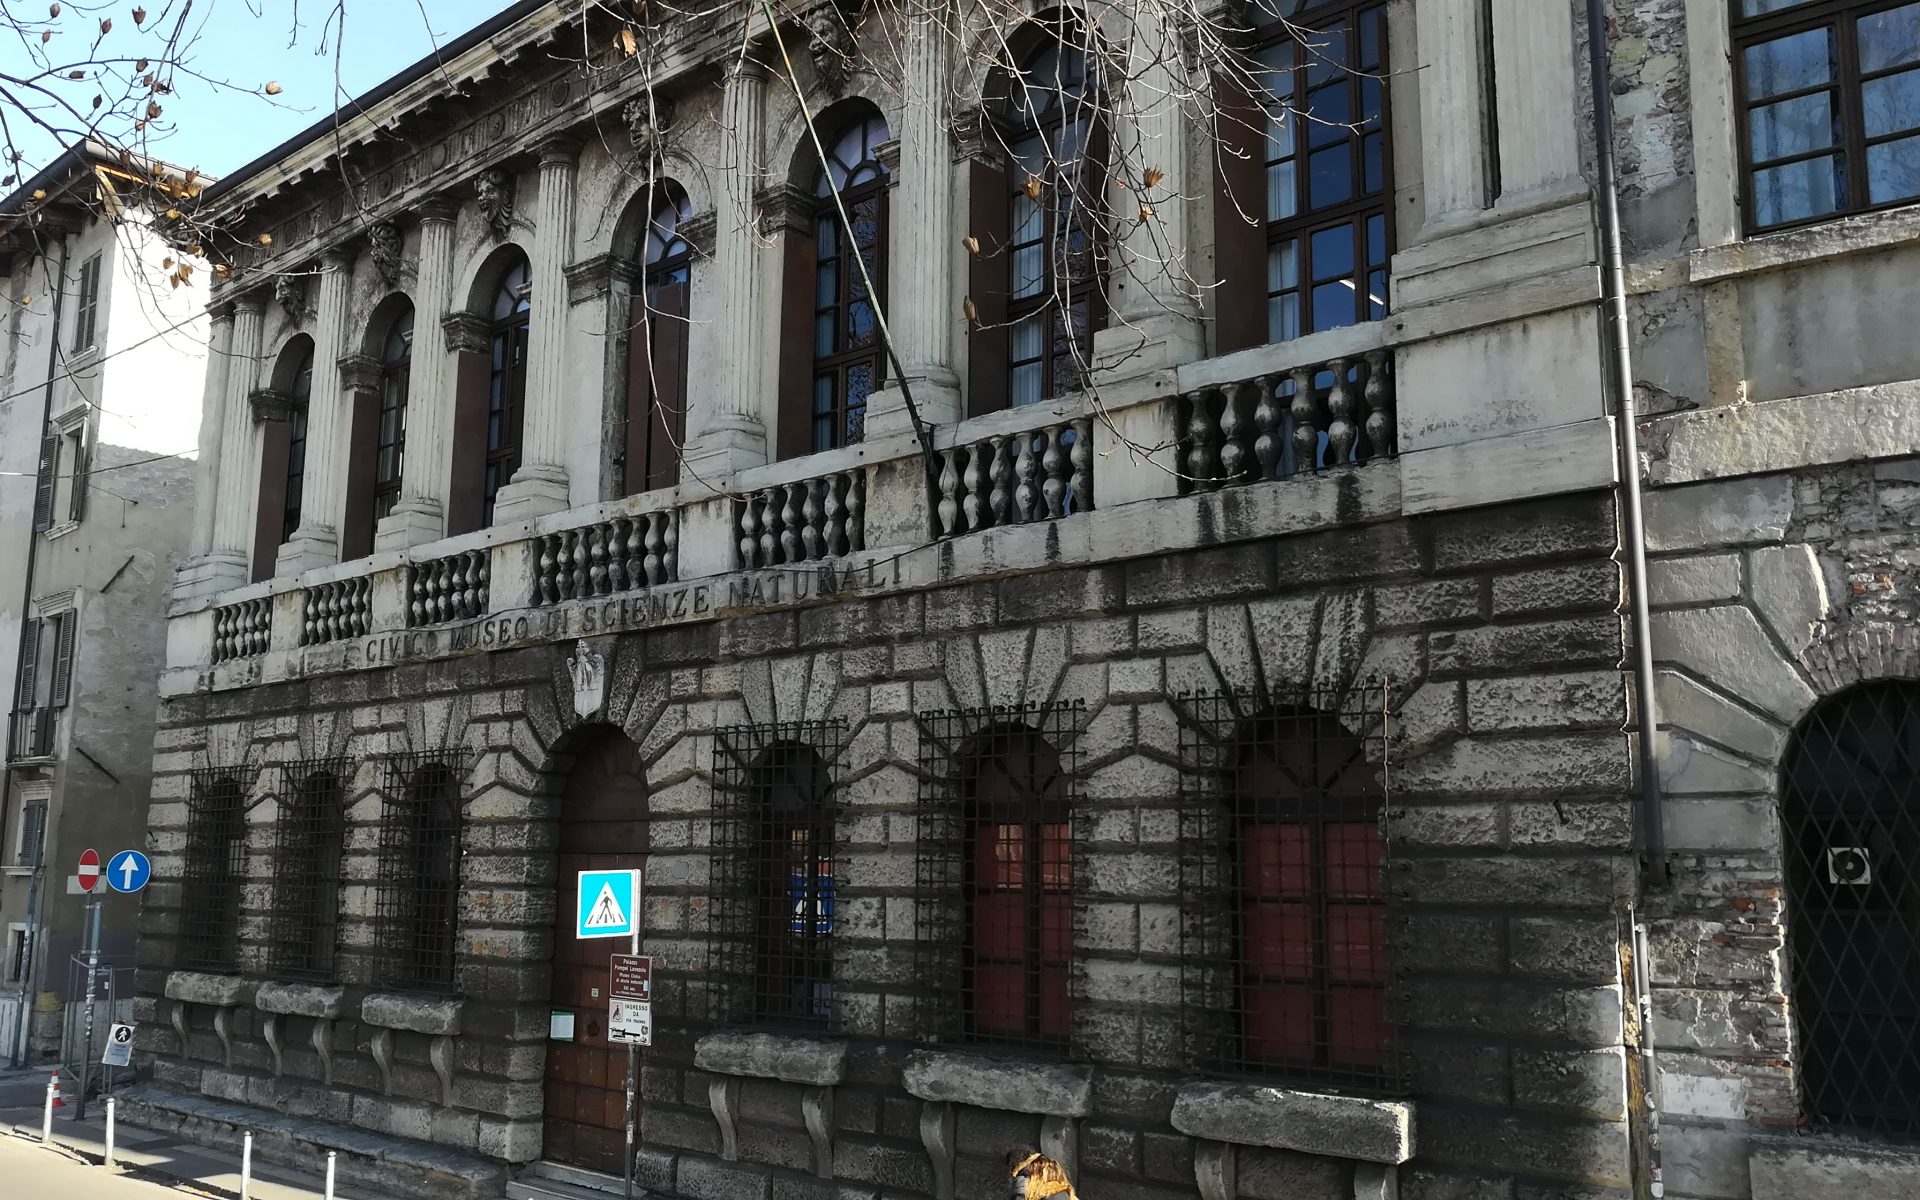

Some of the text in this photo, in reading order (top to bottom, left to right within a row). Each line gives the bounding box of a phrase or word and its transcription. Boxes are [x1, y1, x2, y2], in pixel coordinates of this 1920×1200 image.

[366, 554, 902, 662] CIVICO MUSEO DI SCIENZE NATURALI
